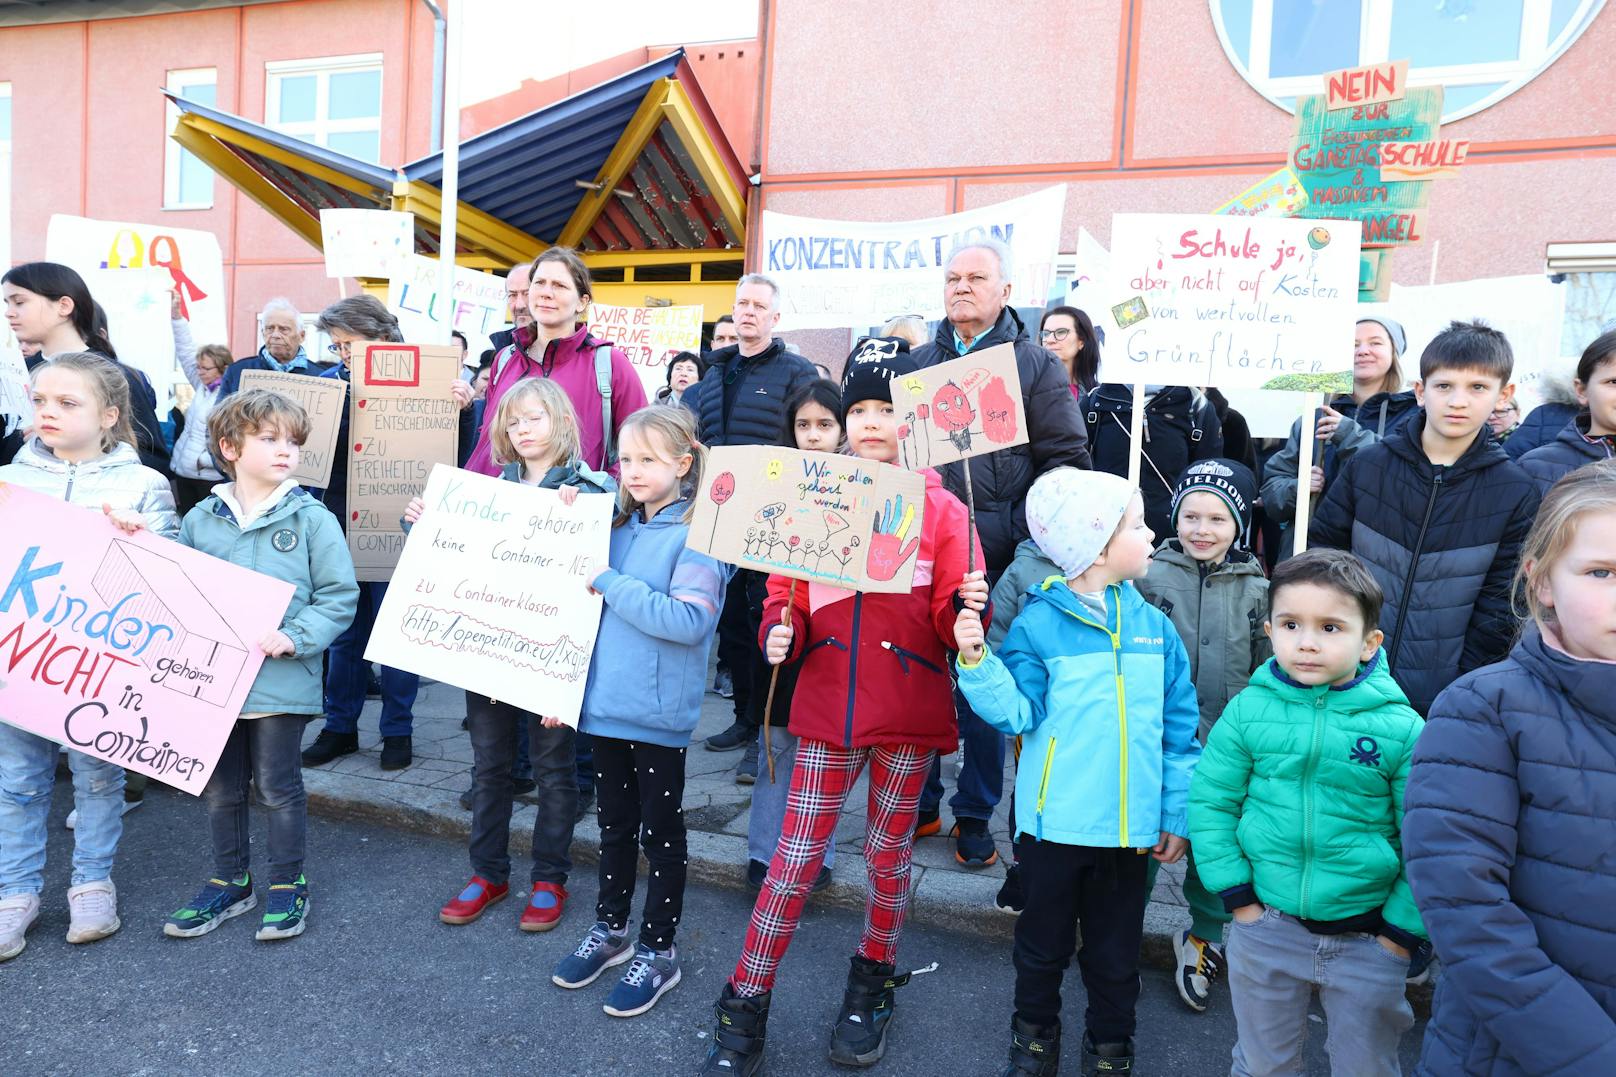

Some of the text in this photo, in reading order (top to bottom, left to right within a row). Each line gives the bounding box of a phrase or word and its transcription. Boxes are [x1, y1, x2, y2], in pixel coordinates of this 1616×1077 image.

[1328, 66, 1395, 104] NEIN
[1352, 102, 1389, 121] ZUR
[1313, 185, 1387, 204] MASSIVEM
[1172, 227, 1305, 271] Schule ja,
[1130, 266, 1340, 304] aber nicht auf Kosten
[399, 283, 497, 335] LUFT
[593, 305, 628, 325] WIR
[1151, 298, 1297, 325] von wertvollen
[589, 324, 650, 345] GERNE
[372, 351, 412, 379] NEIN
[1127, 329, 1325, 386] Grünflächen
[367, 397, 388, 412] ZU
[375, 414, 458, 431] ENTSCHEIDUNGEN
[363, 436, 387, 457] ZU
[803, 458, 831, 478] Wir
[796, 480, 842, 500] gehört
[359, 509, 379, 528] ZU
[436, 478, 512, 522] Kinder
[523, 505, 584, 540] gehören
[357, 533, 406, 553] CONTA
[432, 528, 466, 553] keine
[491, 538, 554, 567] Container
[567, 553, 590, 577] NE
[0, 545, 214, 684] Kinder gehören
[0, 621, 143, 712] NICHT in
[64, 701, 205, 781] Container
